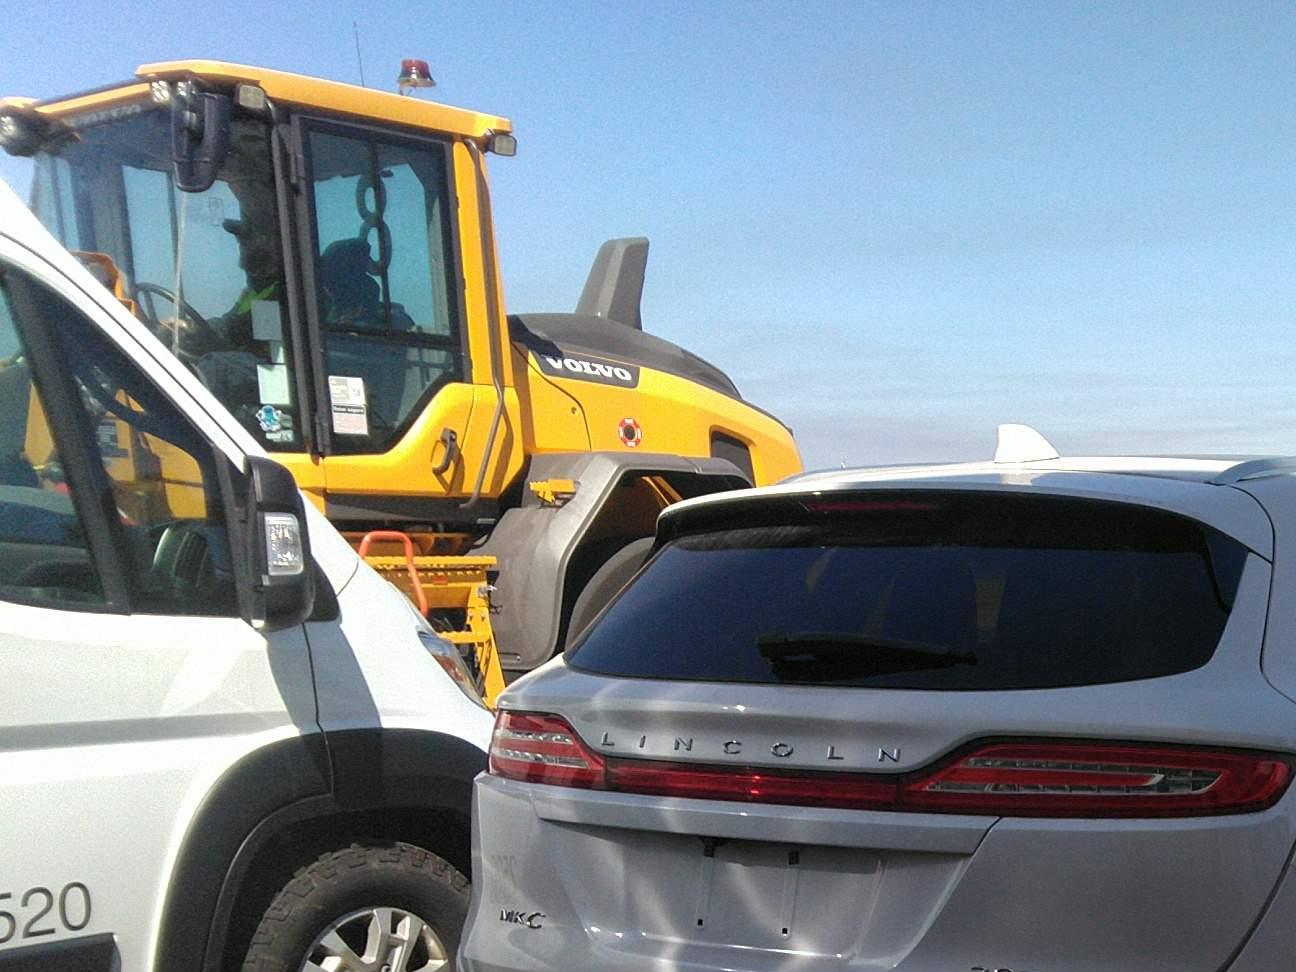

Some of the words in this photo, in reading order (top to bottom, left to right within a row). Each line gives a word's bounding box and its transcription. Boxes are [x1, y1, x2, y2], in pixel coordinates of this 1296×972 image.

[542, 356, 632, 381] VOLVO
[602, 731, 900, 763] LINCOLN
[499, 908, 546, 930] MKC
